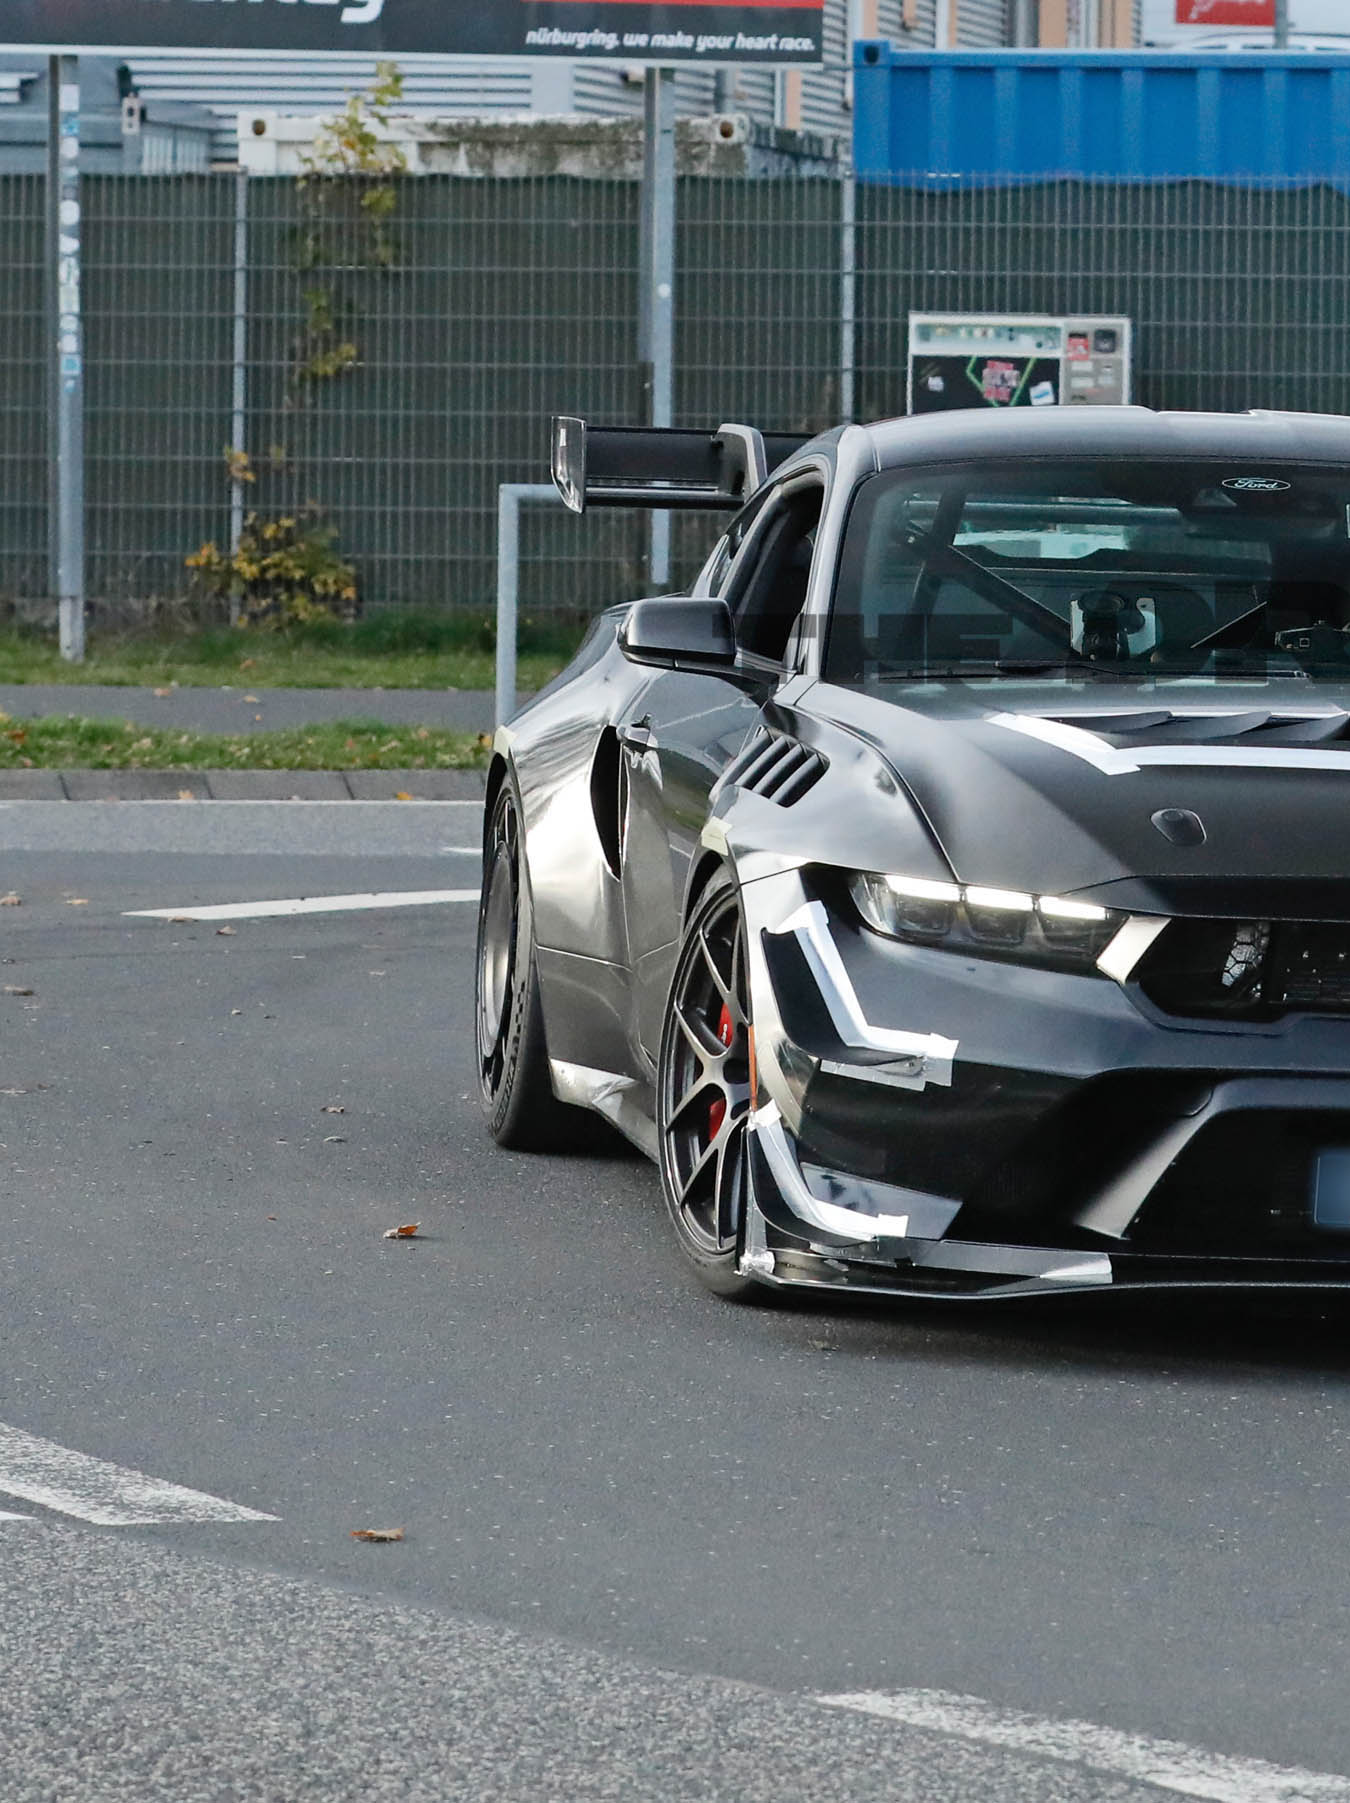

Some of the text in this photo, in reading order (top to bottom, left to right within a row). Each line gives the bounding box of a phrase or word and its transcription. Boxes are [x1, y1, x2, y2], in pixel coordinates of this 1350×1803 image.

[623, 33, 649, 47] we
[650, 30, 694, 48] make
[696, 35, 734, 52] your
[735, 32, 778, 49] heart
[779, 36, 816, 51] race.
[1233, 478, 1280, 489] Ford
